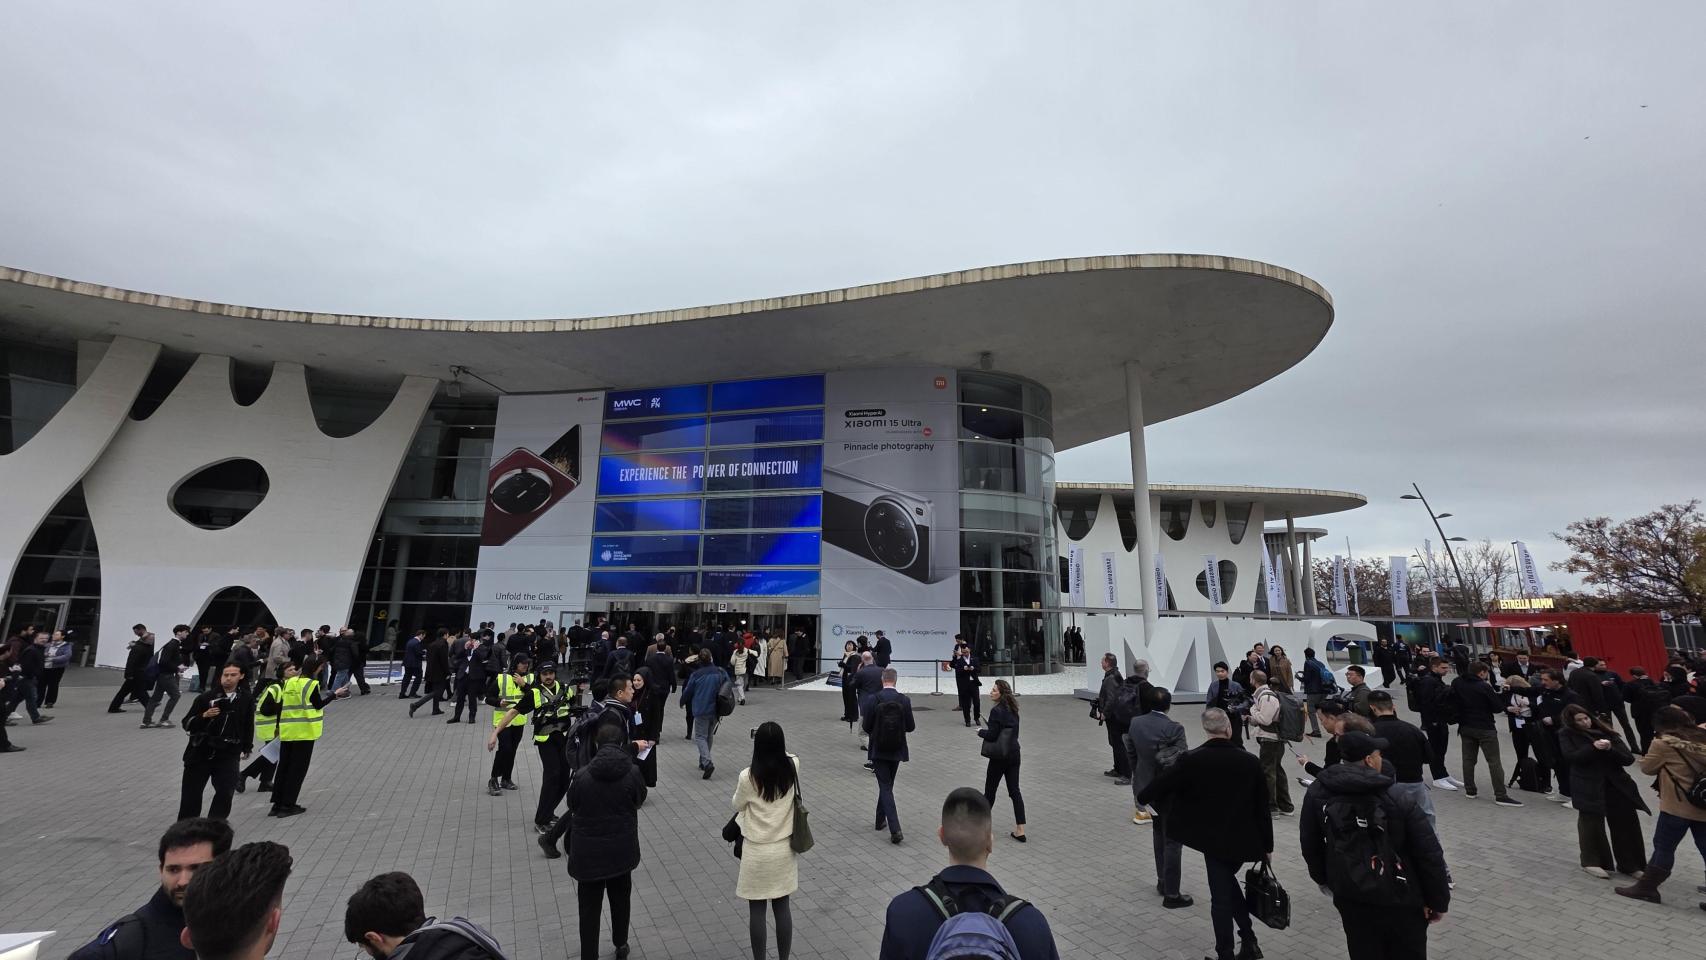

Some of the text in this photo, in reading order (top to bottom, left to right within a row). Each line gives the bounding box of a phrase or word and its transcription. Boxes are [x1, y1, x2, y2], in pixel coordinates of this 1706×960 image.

[614, 399, 642, 408] MWC
[844, 442, 934, 452] Pinnacle photography
[620, 466, 670, 482] EXPERIENCE
[672, 466, 688, 480] THE
[728, 464, 740, 476] OF
[742, 460, 798, 476] CONNECTION
[496, 592, 563, 600] Unfold the Classic
[1500, 598, 1554, 610] ESTRELLA DAMM
